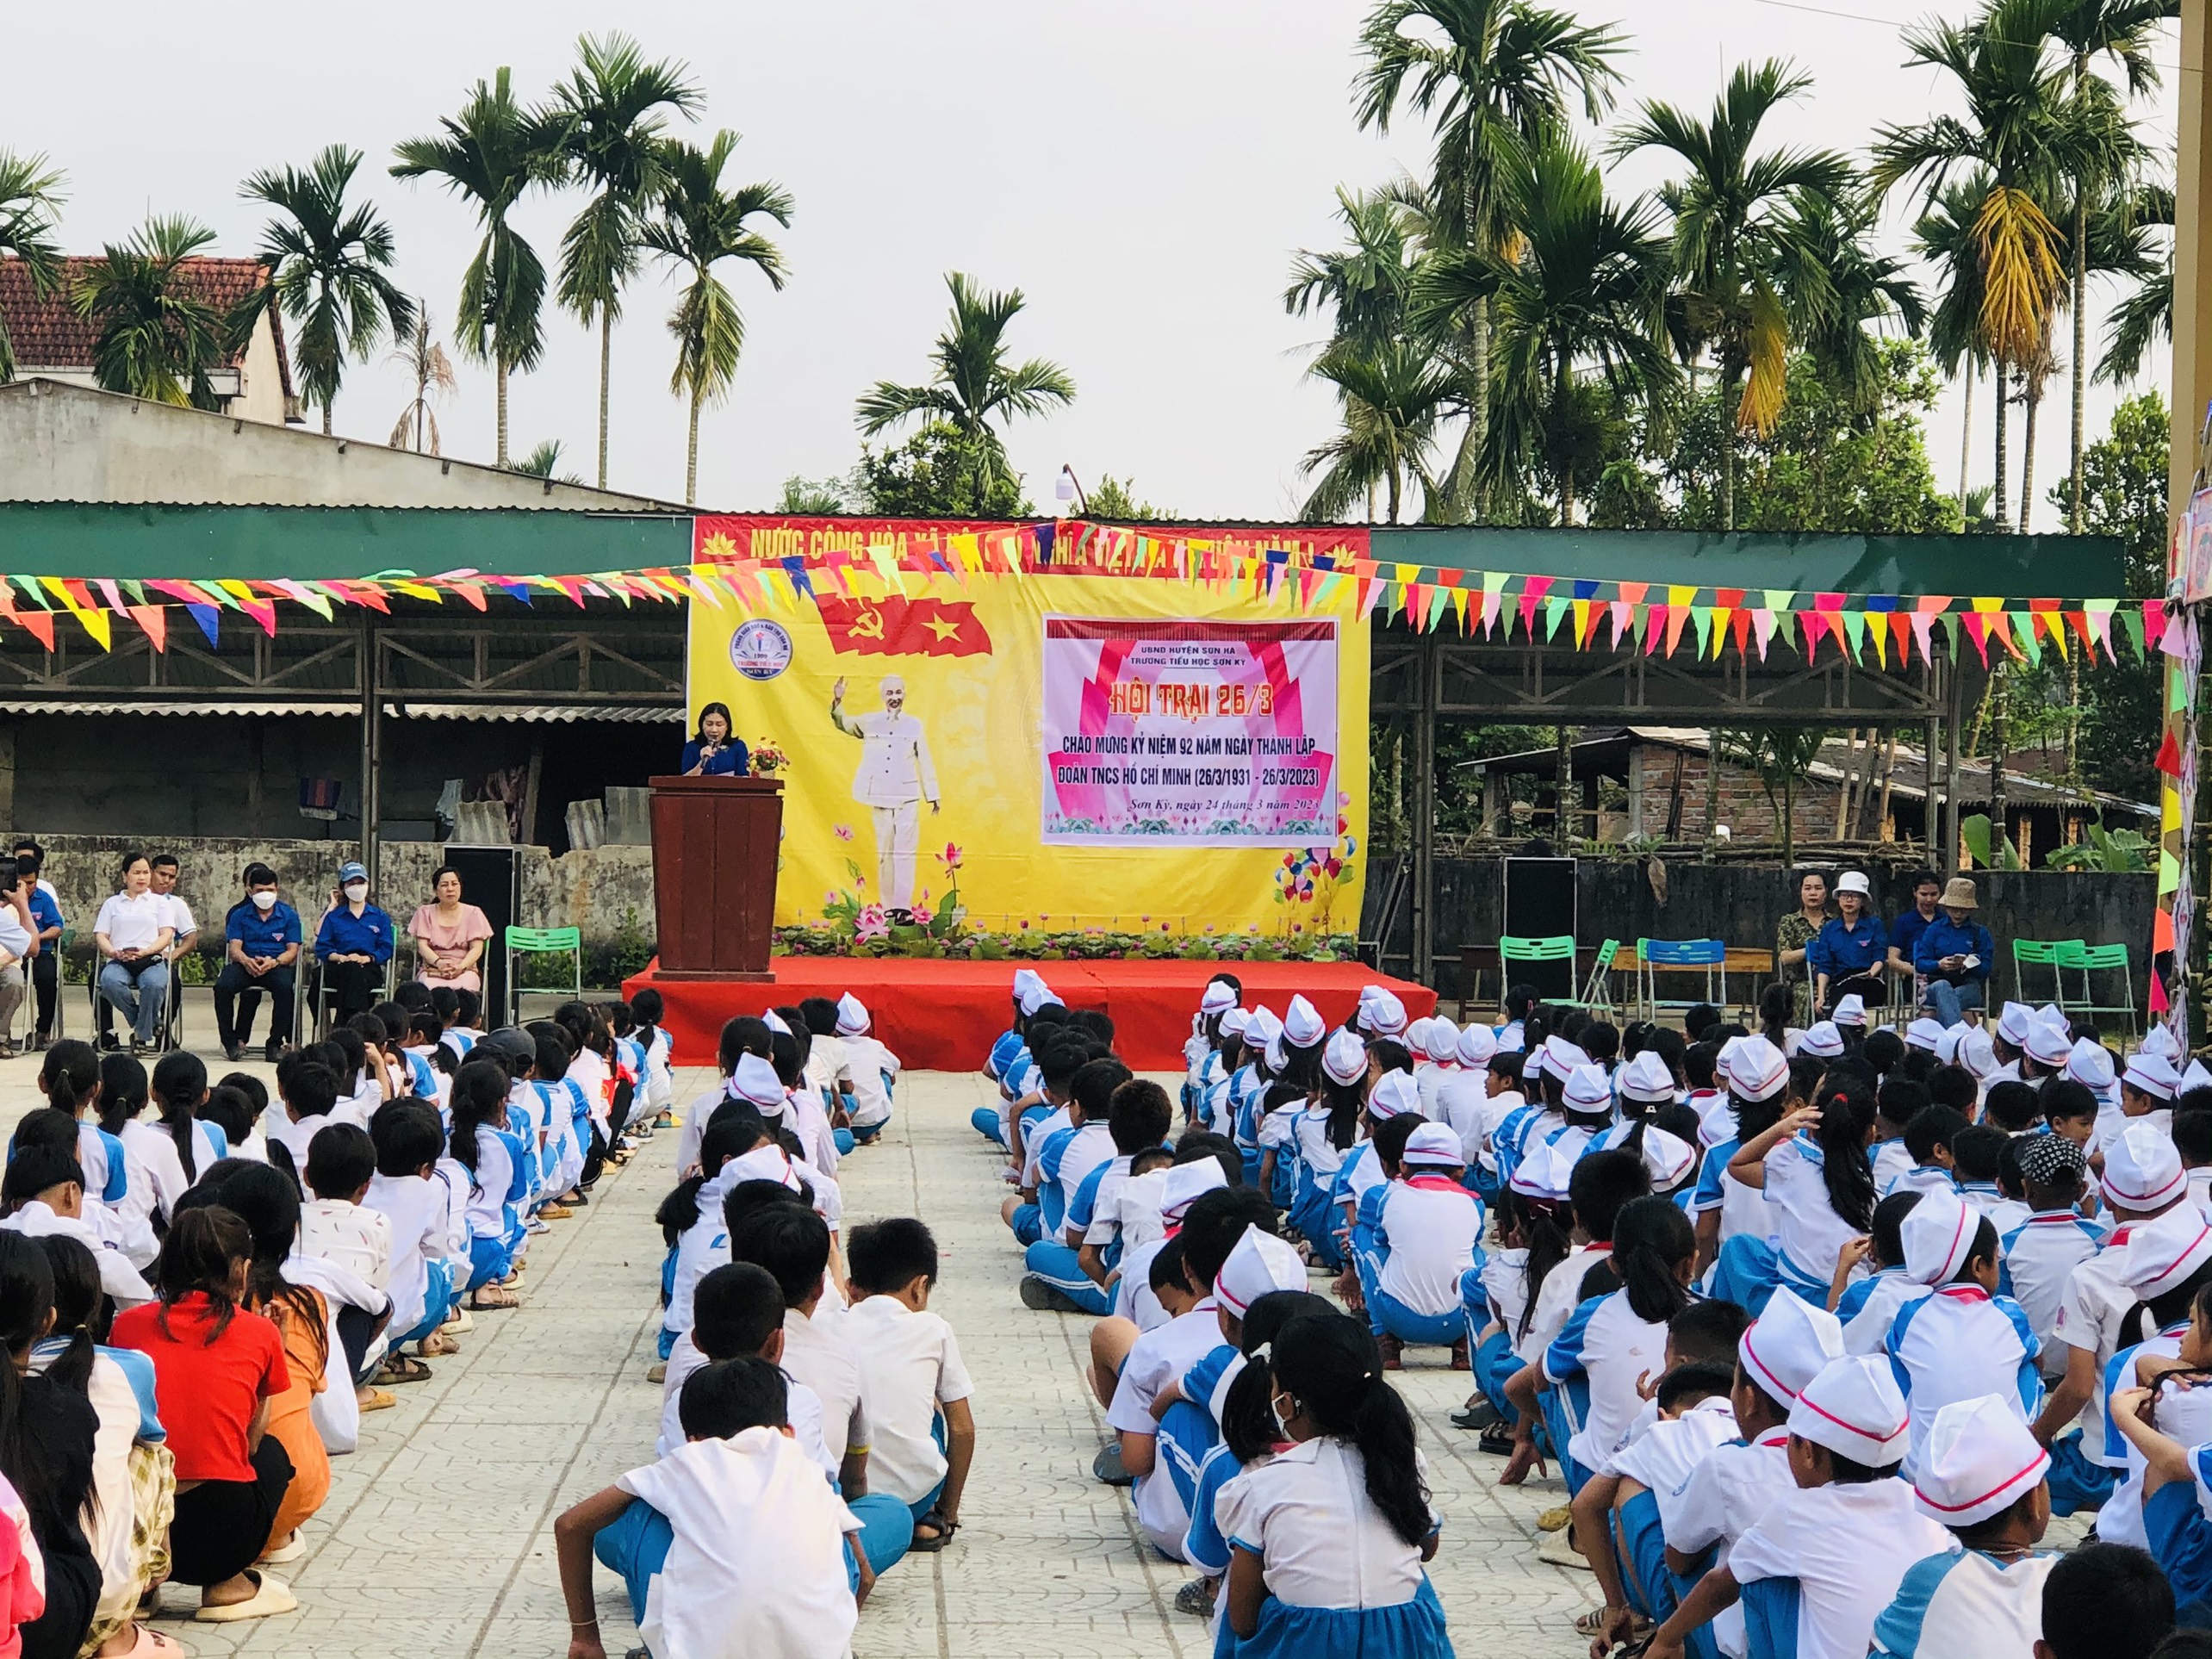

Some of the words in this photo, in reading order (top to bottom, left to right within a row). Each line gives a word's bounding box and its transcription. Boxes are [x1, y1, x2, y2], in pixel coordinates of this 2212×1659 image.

[750, 520, 805, 559] NƯỚC
[1169, 645, 1199, 655] HUYỆN
[1191, 657, 1210, 666] HỌC
[1213, 657, 1232, 666] SƠN
[1109, 676, 1152, 724] HỘI
[1157, 682, 1209, 724] TRẠI
[1216, 683, 1273, 717] 26/3
[1063, 733, 1091, 754] CHÀO
[1095, 733, 1128, 754] MỪNG
[1131, 731, 1145, 755] KỶ
[1148, 733, 1177, 758] NIỆM
[1179, 737, 1193, 755] 92
[1196, 735, 1221, 755] NĂM
[1225, 734, 1254, 755] NGÀY
[1257, 734, 1292, 755] THÀNH
[1296, 734, 1316, 759] LẬP
[1058, 763, 1088, 784] ĐOÀN
[1091, 767, 1119, 785] TNCS
[1140, 764, 1159, 785] CHÍ
[1162, 767, 1191, 786] MINH
[1195, 768, 1250, 787] (26/3/1931
[1262, 768, 1320, 787] 26/3/2023)
[1131, 798, 1152, 810] Sơn
[1176, 799, 1202, 812] ngày
[1205, 799, 1219, 810] 24
[1221, 799, 1253, 812] tháng
[1256, 799, 1263, 810] 3
[1266, 799, 1289, 810] năm
[1293, 799, 1320, 810] 2023
